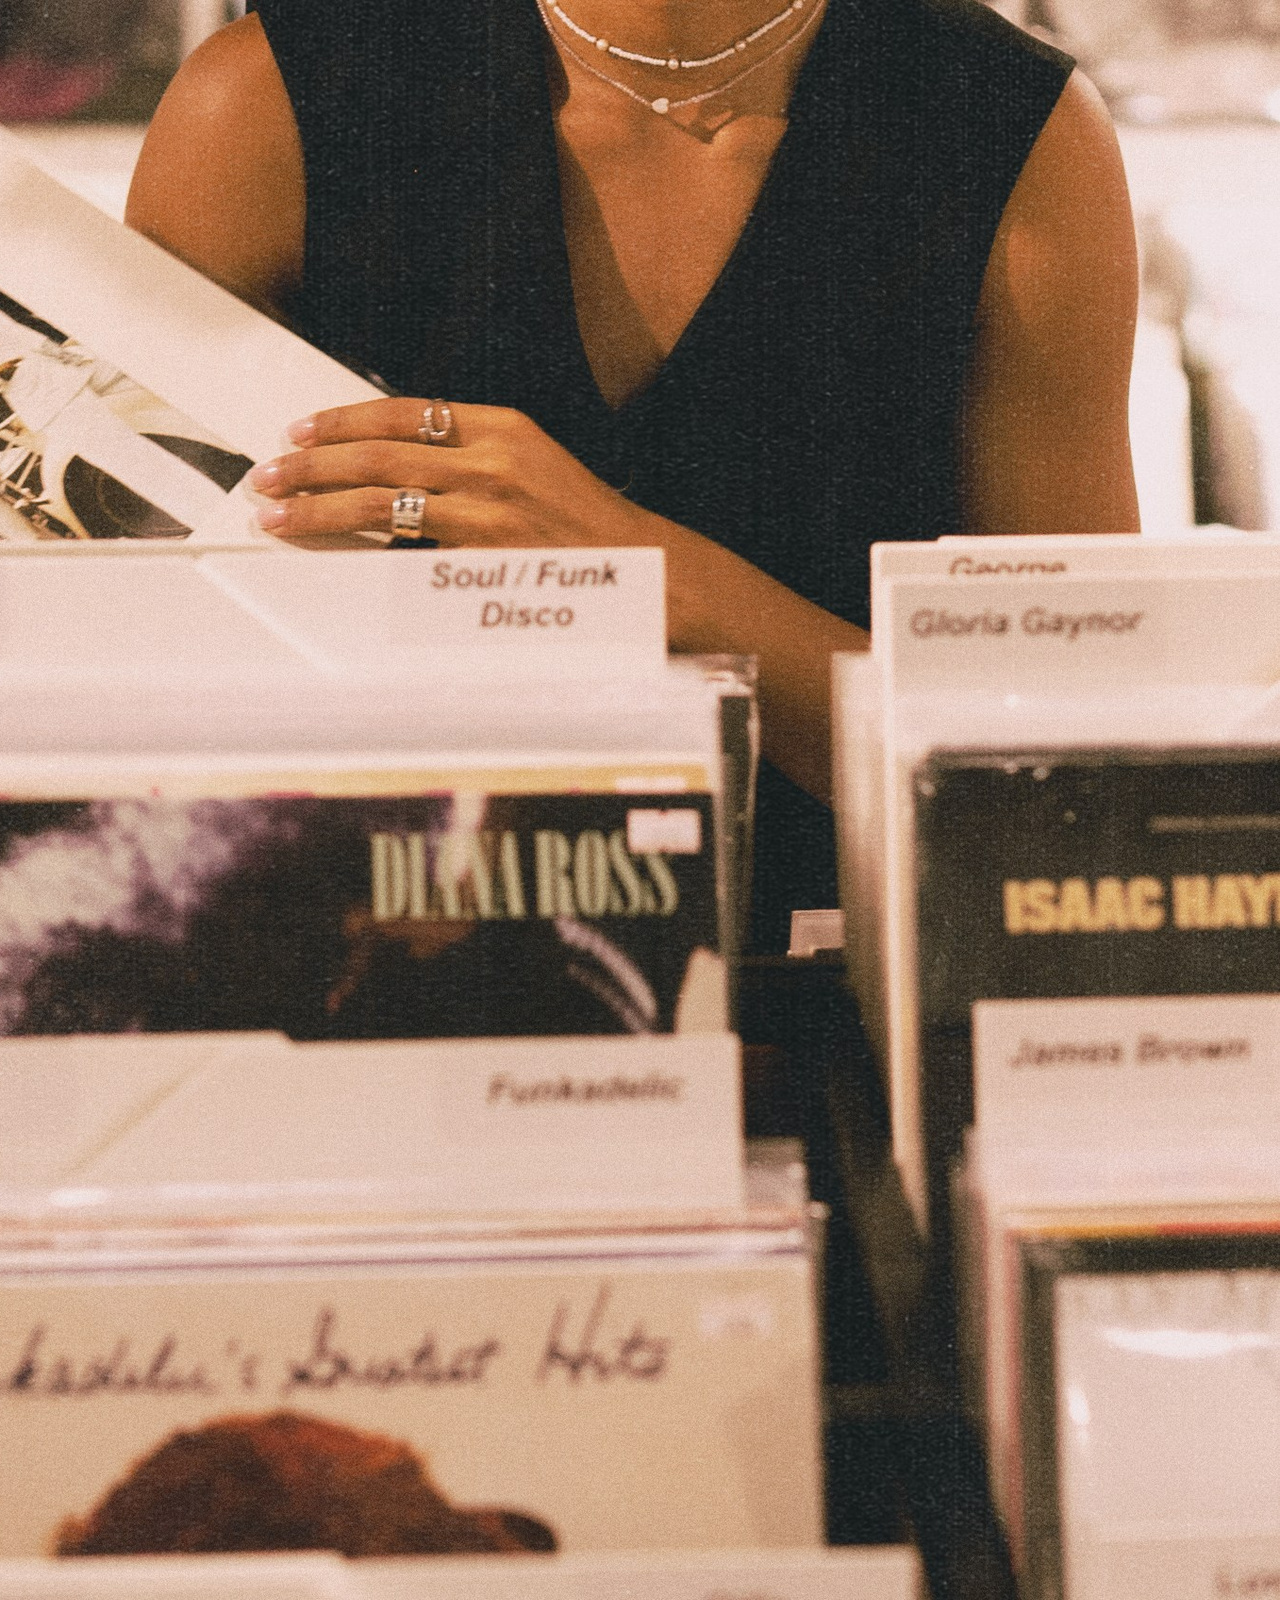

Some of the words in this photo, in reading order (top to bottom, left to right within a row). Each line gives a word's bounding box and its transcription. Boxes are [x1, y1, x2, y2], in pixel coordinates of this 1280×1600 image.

[431, 560, 507, 589] Soul
[515, 561, 528, 587] /
[536, 559, 618, 588] Funk
[480, 600, 575, 628] Disco
[910, 607, 1010, 639] Gloria
[1021, 605, 1146, 642] Gaynor
[371, 828, 525, 920] DIANA
[534, 828, 680, 918] ROSS
[1002, 875, 1166, 935] ISAAC
[1171, 871, 1280, 931] HAY
